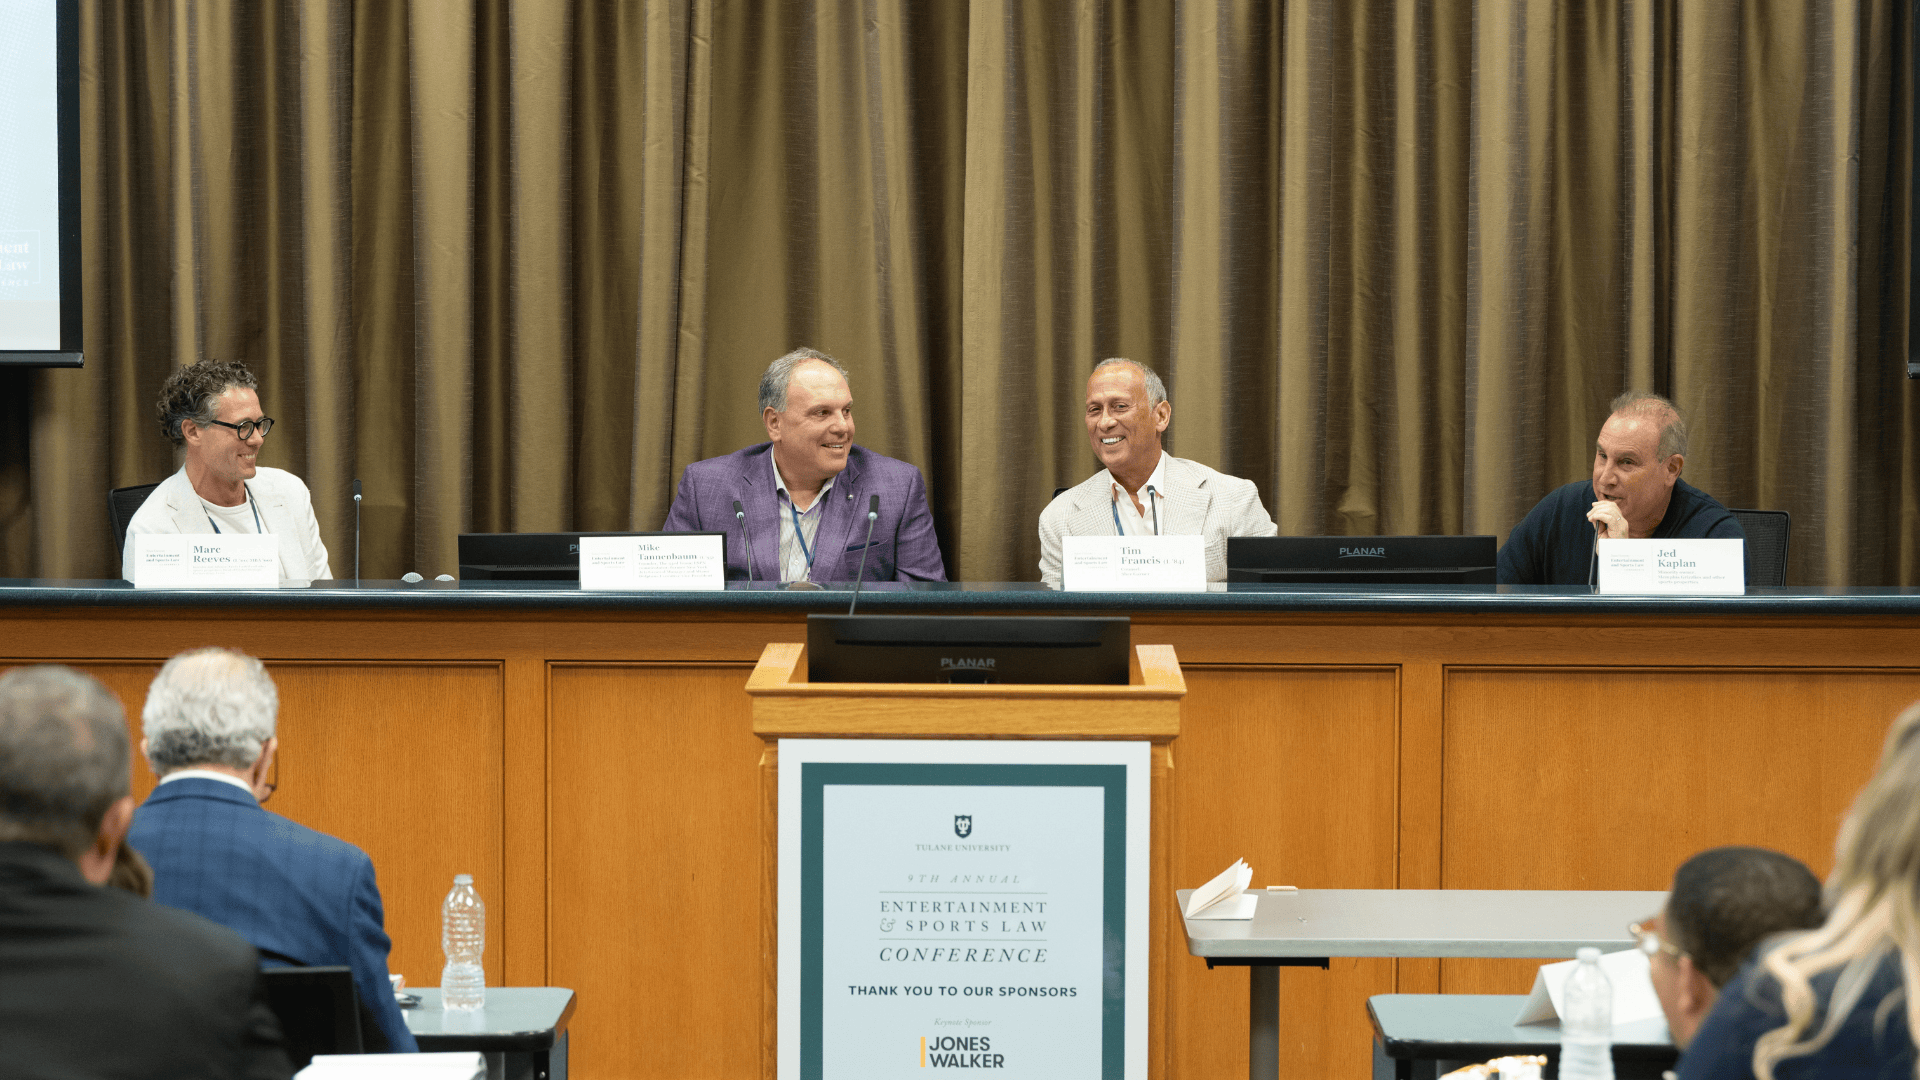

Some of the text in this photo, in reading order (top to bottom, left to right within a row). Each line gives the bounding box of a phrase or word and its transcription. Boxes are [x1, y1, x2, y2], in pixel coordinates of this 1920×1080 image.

[193, 545, 221, 553] Marc
[1120, 546, 1141, 555] Tim
[1340, 547, 1385, 555] PLANAR
[1657, 549, 1676, 558] Jed
[193, 555, 231, 563] Reeves
[1121, 556, 1161, 565] Francis
[1658, 559, 1696, 569] Kaplan
[941, 658, 996, 667] PLANAR
[955, 844, 1011, 852] UNIVERSITY
[907, 875, 1021, 884] 9TH ANNUAL
[880, 901, 1047, 914] ENTERTAINMENT
[879, 918, 1047, 933] & SPORTS LAW
[879, 947, 1048, 963] CONFERENCE
[848, 985, 1078, 997] THANK YOU TO OUR SPONSORS
[933, 1018, 992, 1028] Keynote Sponsor
[929, 1036, 991, 1051] JONES
[929, 1053, 1005, 1069] WALKER
